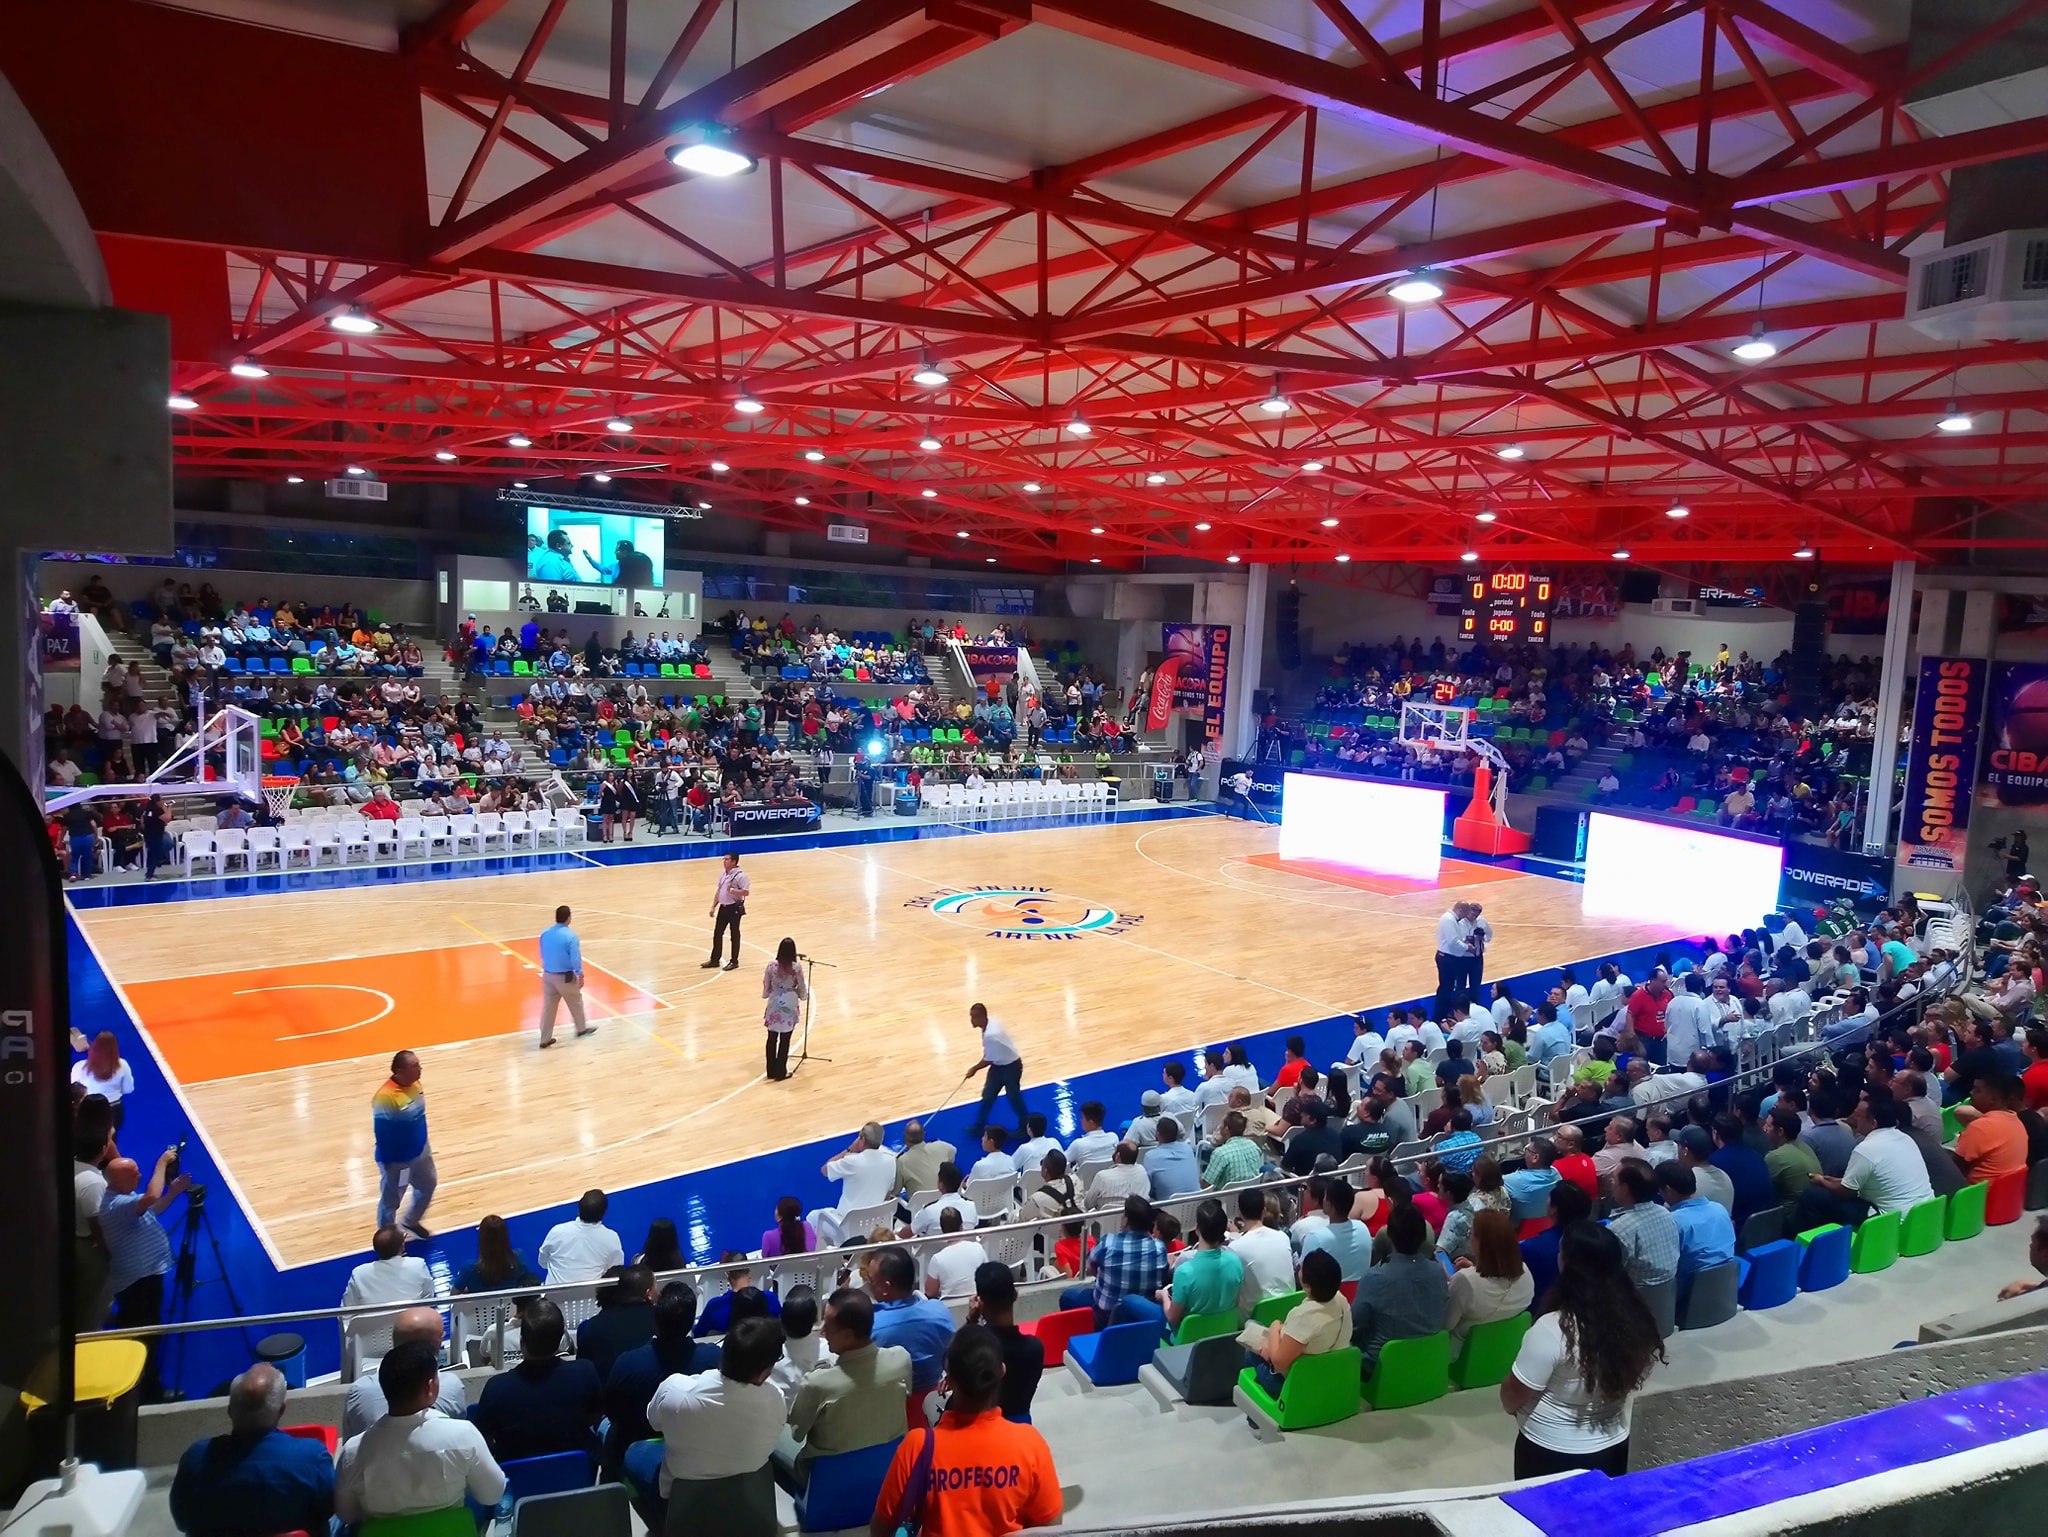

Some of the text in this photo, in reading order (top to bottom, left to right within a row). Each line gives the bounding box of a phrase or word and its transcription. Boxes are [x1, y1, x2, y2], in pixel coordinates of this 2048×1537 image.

[1467, 574, 1481, 582] Local
[1491, 574, 1525, 590] 10:00
[1473, 583, 1483, 599] 0
[1538, 584, 1549, 600] 0
[1465, 618, 1473, 630] 0
[1534, 620, 1542, 633] 0
[46, 638, 70, 654] PAZ
[1207, 628, 1228, 708] EQUIPO
[1435, 683, 1455, 700] 24
[1205, 713, 1221, 739] EL
[1920, 661, 1971, 842] SOMOS TODOS
[1987, 773, 2001, 783] EL
[734, 807, 815, 821] POWERADE
[985, 930, 1083, 941] ARENA
[927, 1464, 1020, 1493] PROFESOR
